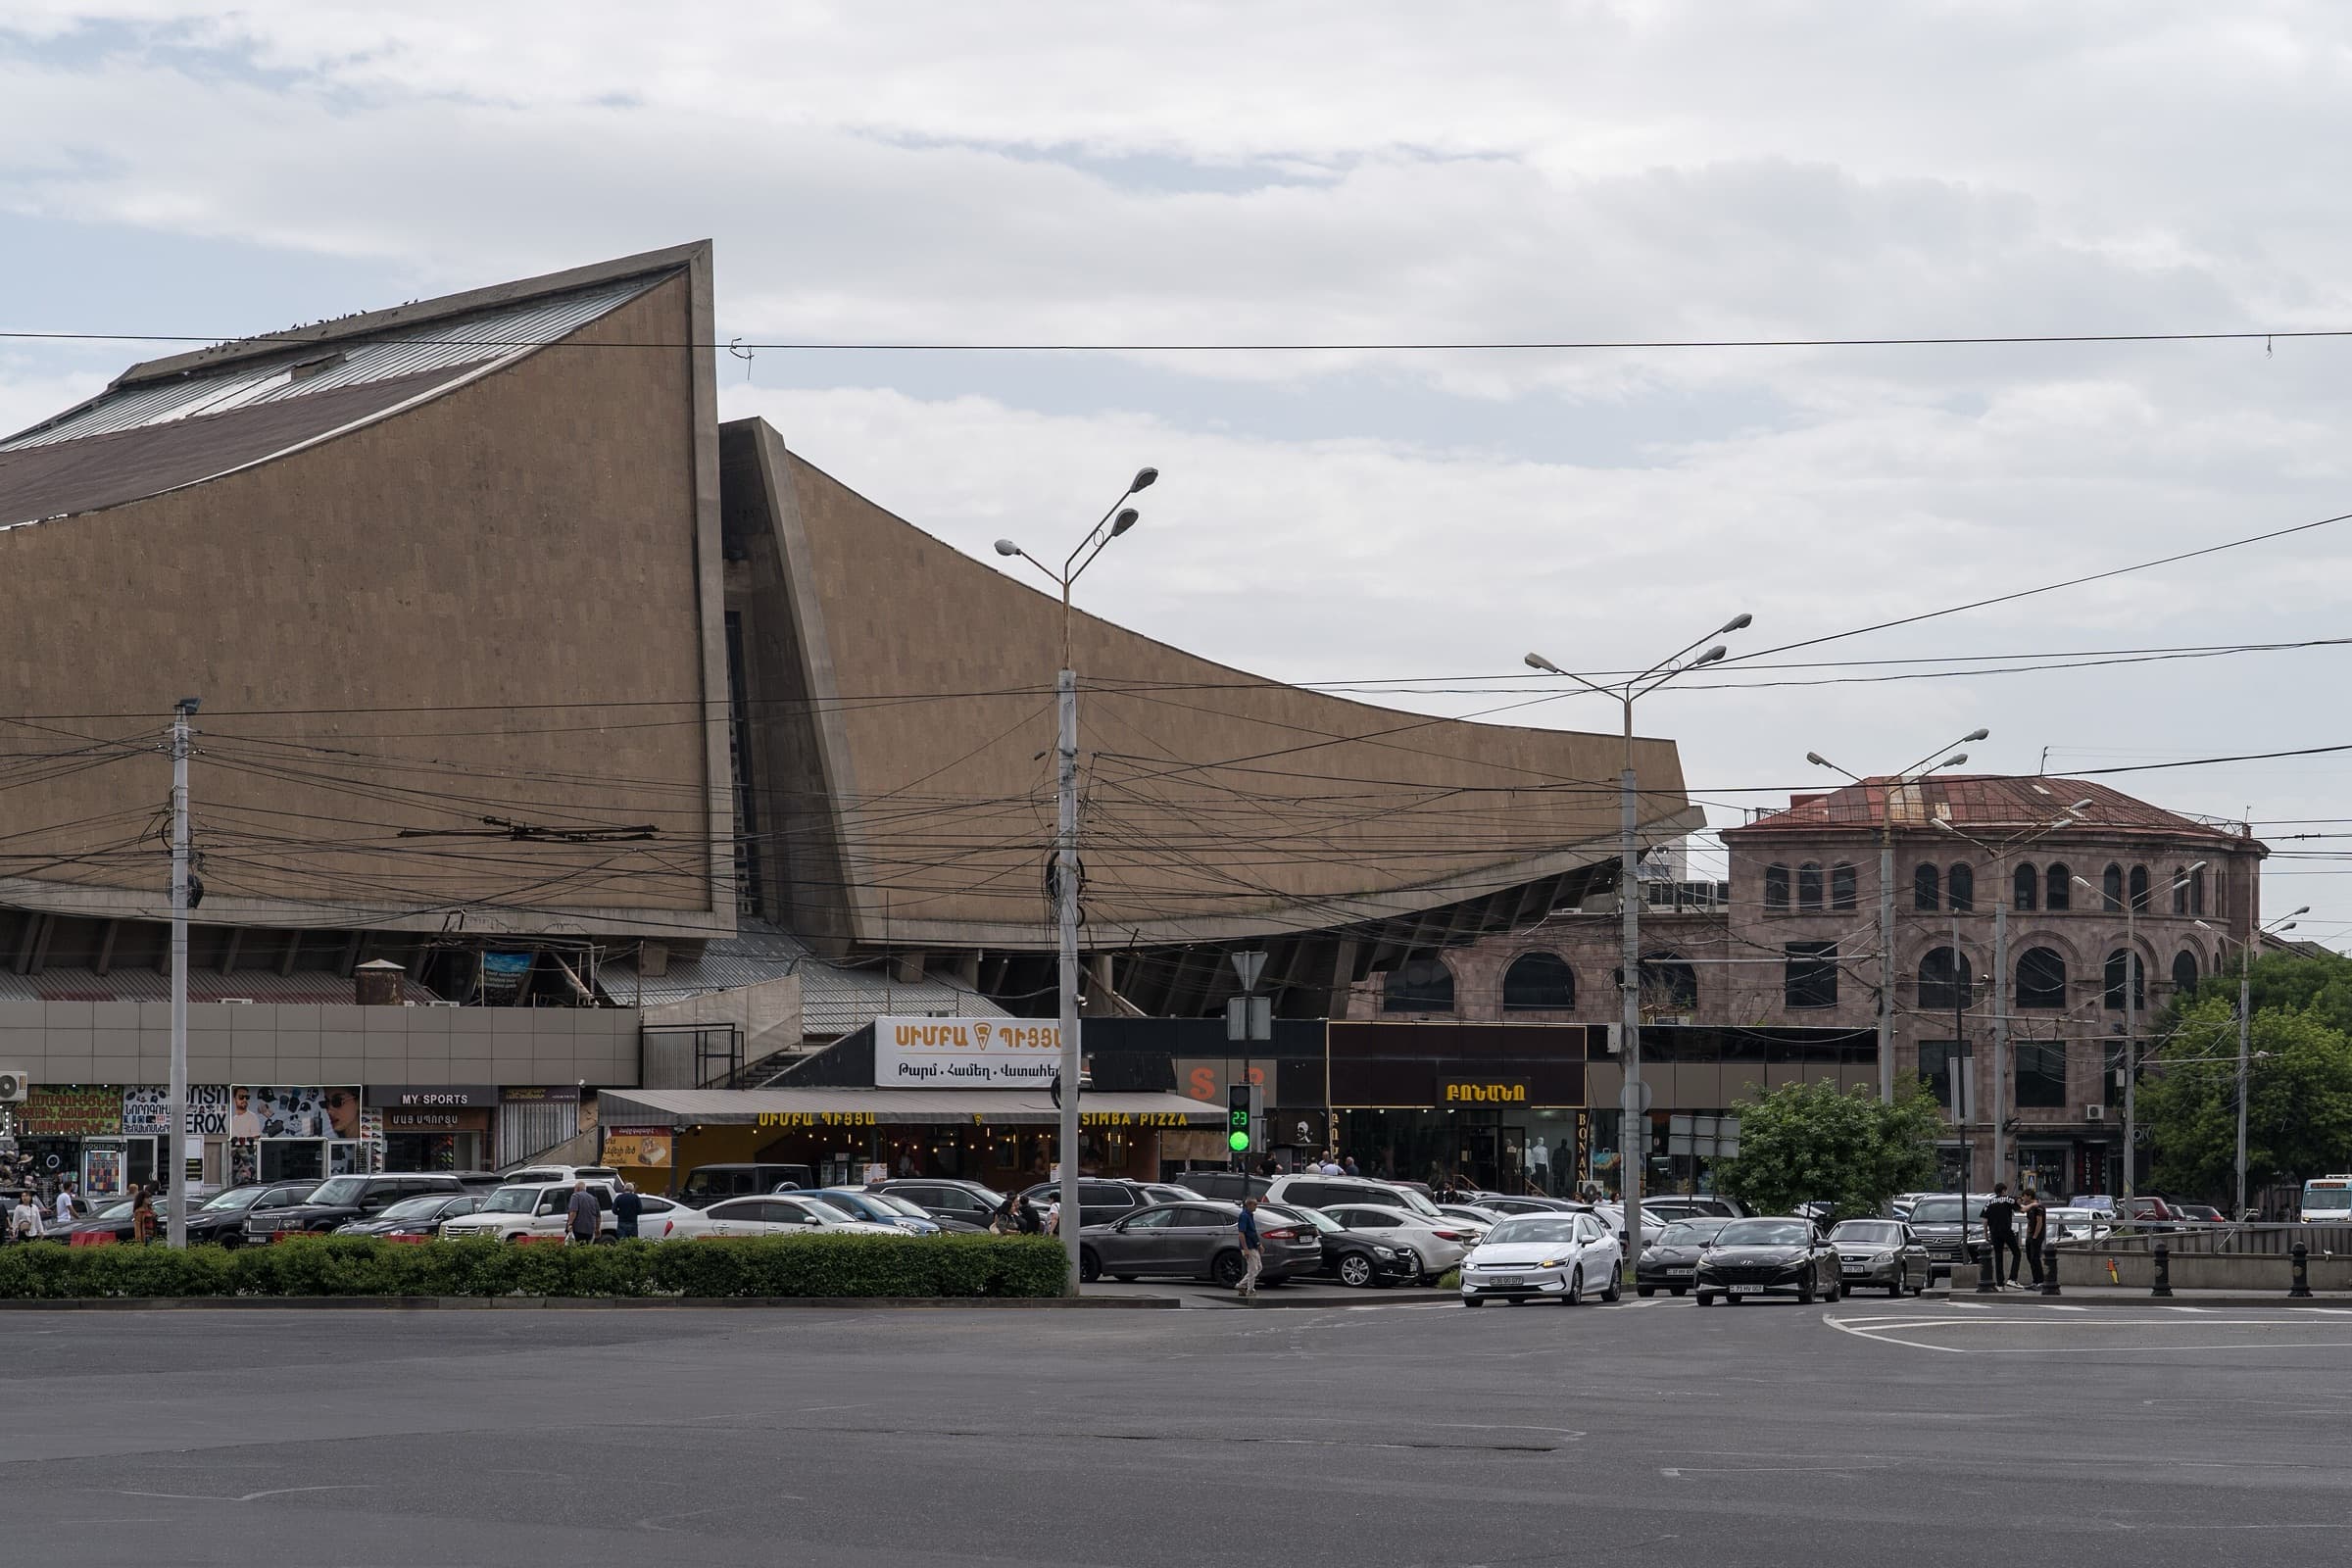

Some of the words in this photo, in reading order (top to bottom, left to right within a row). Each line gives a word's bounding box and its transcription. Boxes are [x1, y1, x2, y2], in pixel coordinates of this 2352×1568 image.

[895, 1025, 968, 1047] ՍԻՄԲԱ
[898, 1062, 937, 1080] Թարմ
[947, 1062, 990, 1080] Համեղ
[186, 1085, 228, 1104] ՈՏՈ
[402, 1094, 418, 1104] MY
[422, 1094, 468, 1104] SPORTS
[1446, 1084, 1526, 1102] ԲՈՆԱՆՈ
[185, 1113, 226, 1133] EROX
[759, 1112, 813, 1126] ՍԻՄԲԱ
[1081, 1111, 1131, 1126] SIMBA
[1140, 1112, 1188, 1126] PIZZA
[1232, 1111, 1248, 1126] 23
